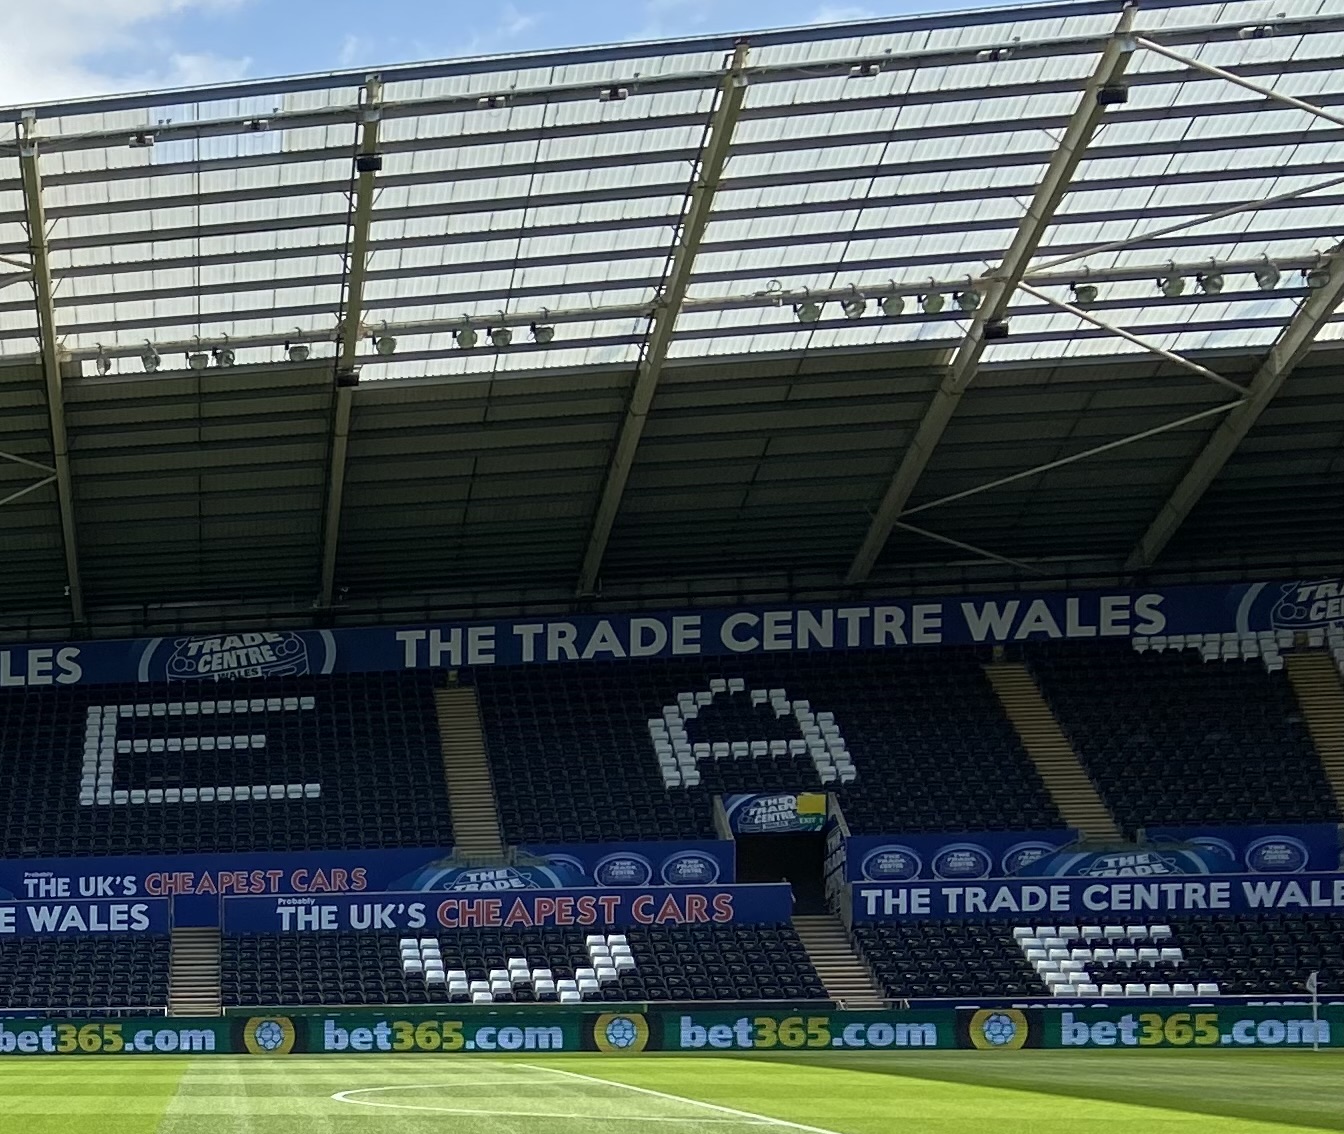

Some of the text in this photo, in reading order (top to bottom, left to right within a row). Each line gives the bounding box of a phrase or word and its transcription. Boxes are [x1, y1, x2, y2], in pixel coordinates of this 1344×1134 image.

[187, 632, 284, 656] TRADE
[396, 594, 1166, 668] THE TRADE CENTRE WALES
[198, 645, 278, 673] CENTRE
[466, 870, 508, 882] THE
[1104, 854, 1150, 867] THE
[23, 867, 368, 898] THE UK'S CHEAPEST CARS
[861, 887, 931, 915] THE
[942, 885, 1071, 913] TRADE
[1082, 881, 1231, 911] CENTRE
[26, 903, 150, 932] WALES
[276, 893, 734, 931] THE UK'S CHEAPEST CARS
[278, 898, 316, 907] Probably
[324, 1019, 564, 1051] bet365.com
[680, 1015, 937, 1049] bet365.com
[1061, 1012, 1331, 1046] bet365.com
